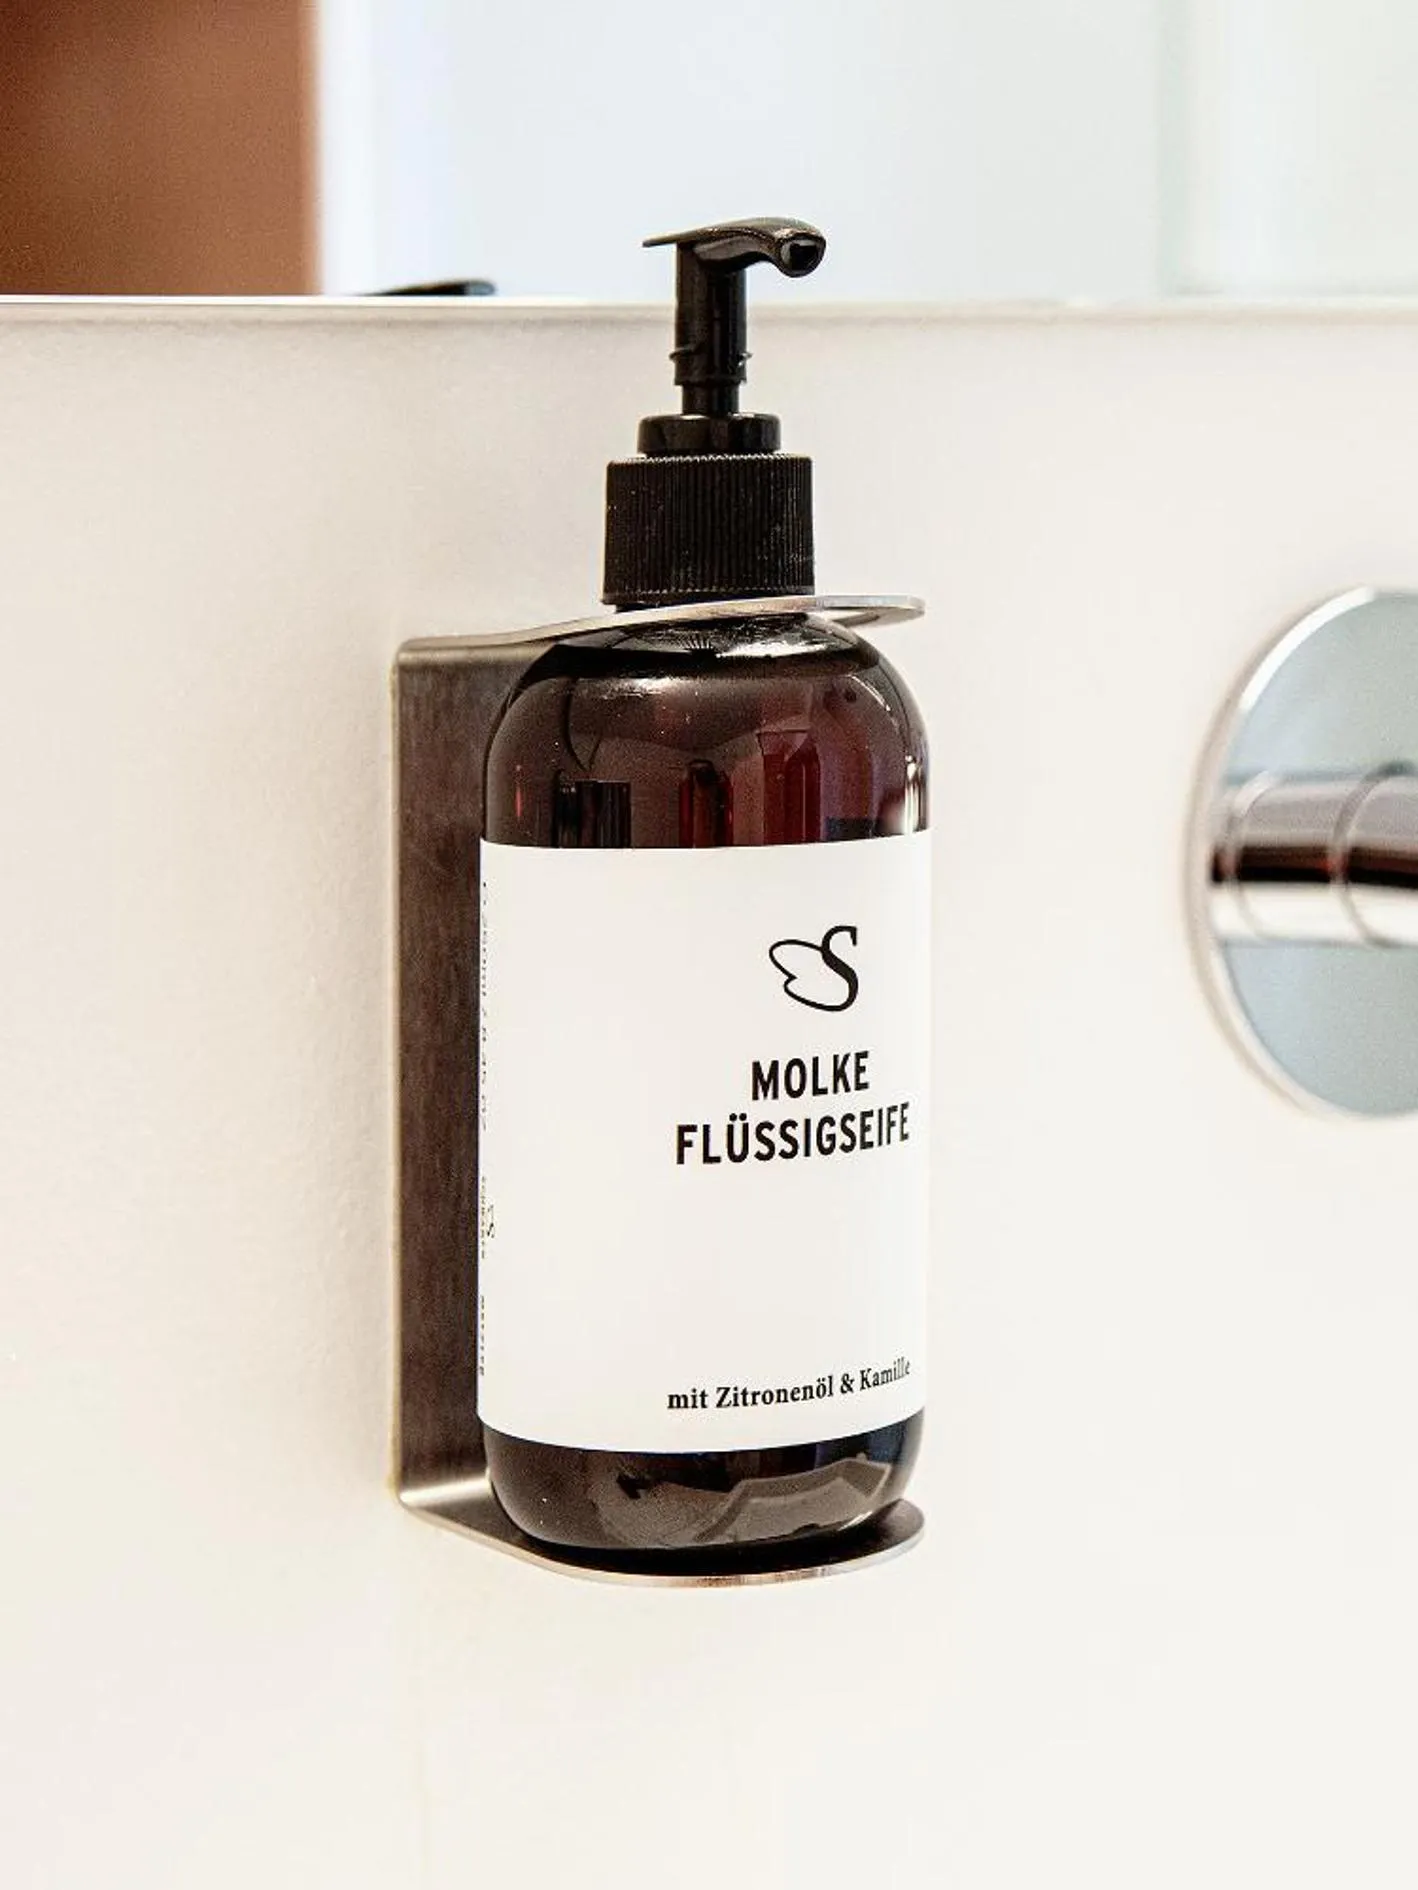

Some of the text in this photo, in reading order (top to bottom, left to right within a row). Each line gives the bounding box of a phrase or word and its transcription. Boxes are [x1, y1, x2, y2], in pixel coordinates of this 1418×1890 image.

[751, 1050, 870, 1101] MOLKE
[676, 1101, 910, 1165] FLÜSSIGSEIFE
[667, 1356, 911, 1409] mit Zitronenöl & Kamille
